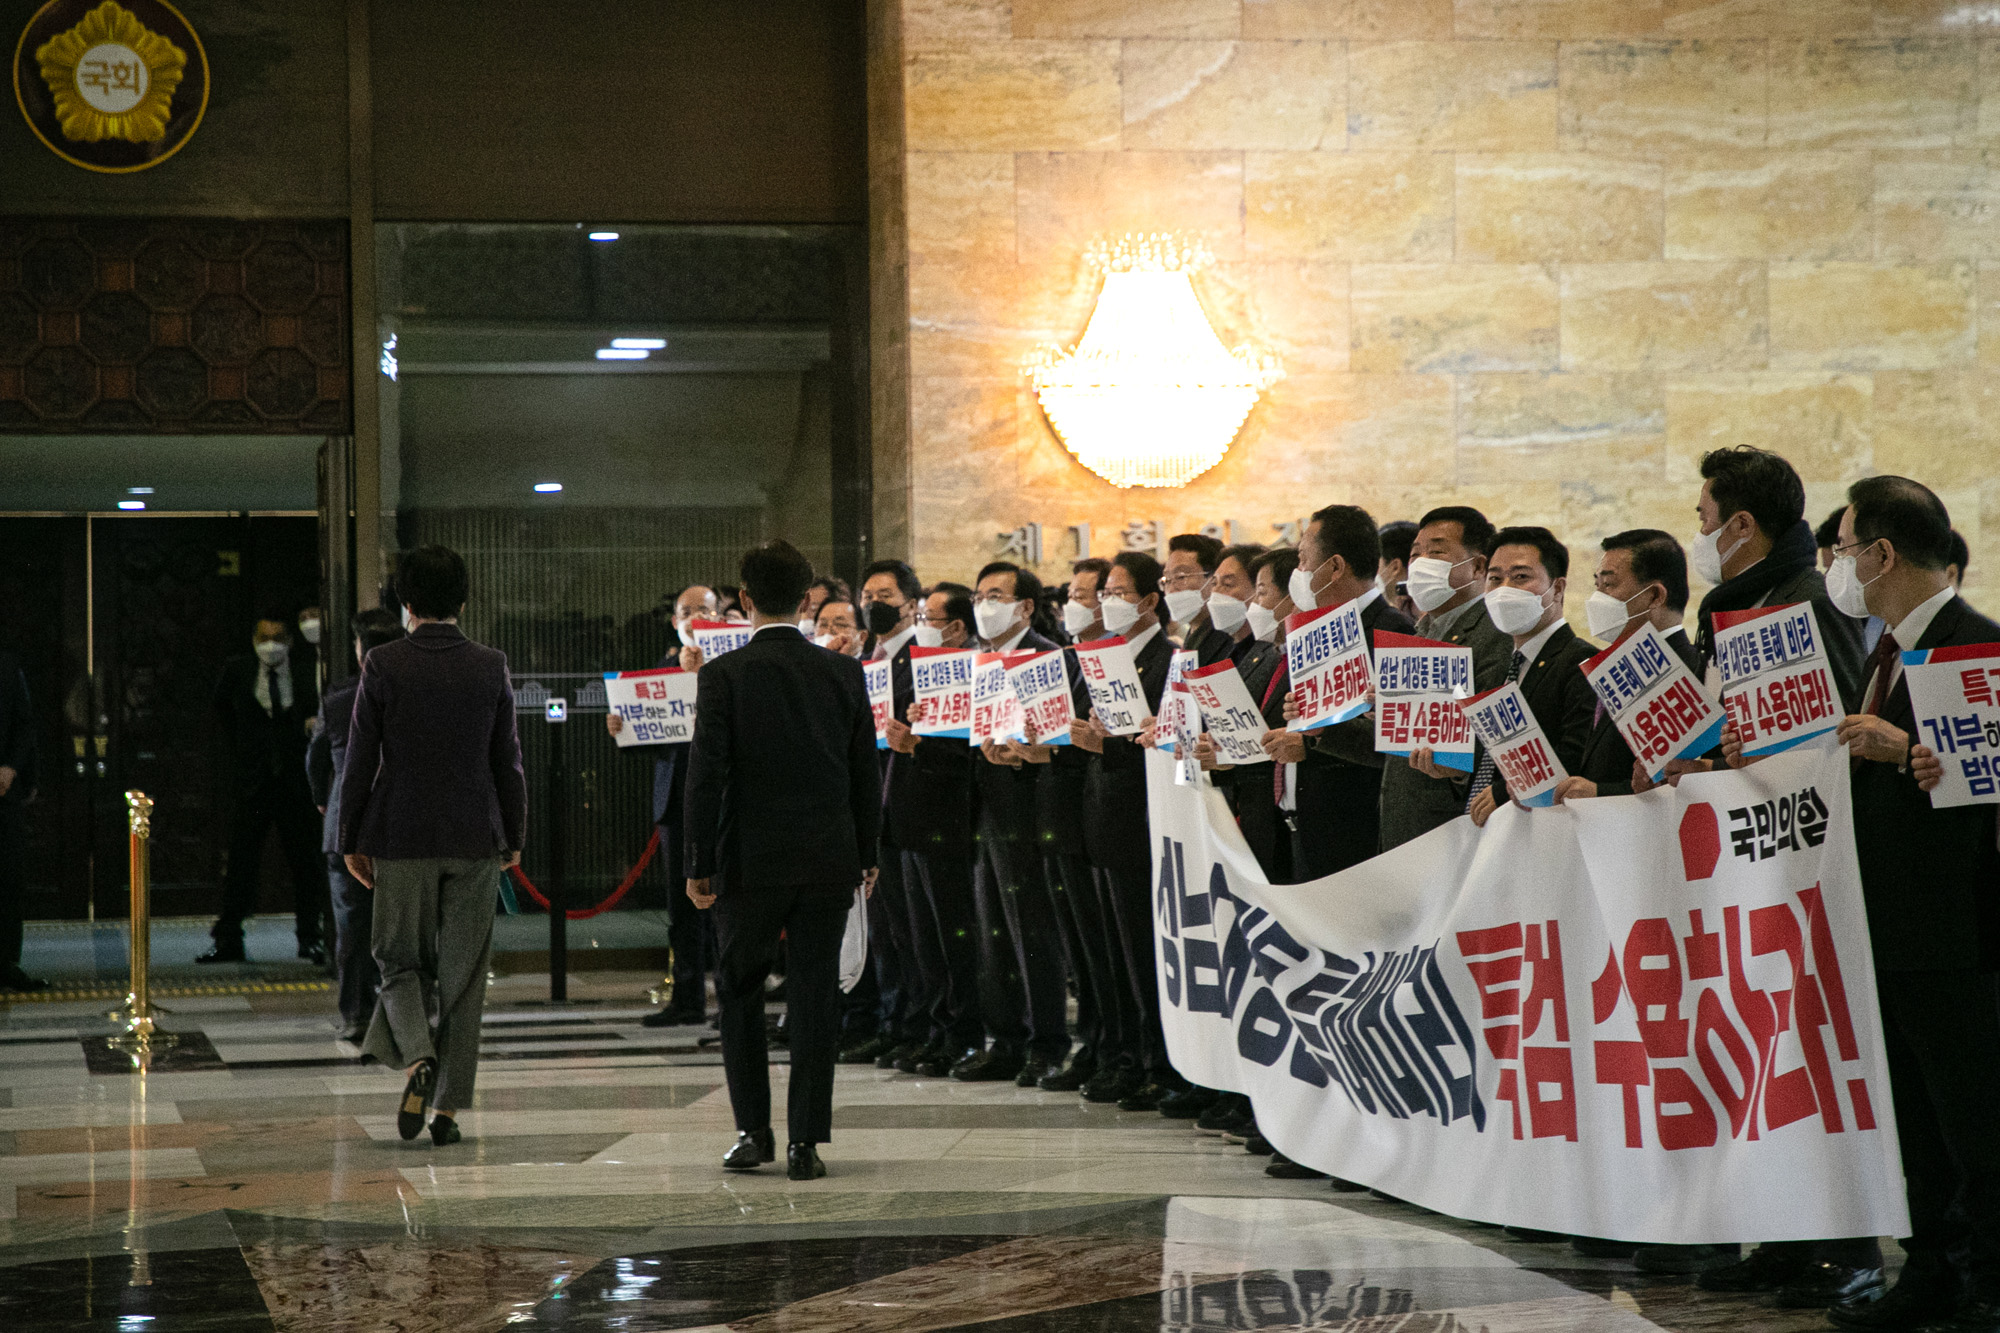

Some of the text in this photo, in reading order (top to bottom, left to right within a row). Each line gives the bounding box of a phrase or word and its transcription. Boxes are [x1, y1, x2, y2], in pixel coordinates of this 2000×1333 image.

[81, 61, 140, 96] 국회
[1290, 607, 1361, 673] 성남 대장동 특혜 비리
[1729, 632, 1761, 677] 대장동
[1759, 621, 1788, 666] 특혜
[1783, 611, 1816, 657] 비리
[917, 664, 930, 689] 성남
[931, 661, 951, 687] 대장동
[1080, 656, 1106, 680] 특검
[1379, 655, 1469, 690] 성남 대장동 특혜 비리
[1608, 654, 1646, 698] 특혜
[1631, 632, 1672, 679] 비리
[634, 680, 667, 700] 특검
[1108, 678, 1139, 702] 자가
[1190, 683, 1222, 709] 특검
[1294, 653, 1371, 721] 특검 수용하라!
[1756, 667, 1836, 738] 수용하라!
[615, 703, 668, 723] 거부하는
[1225, 706, 1259, 731] 자가
[1381, 701, 1411, 744] 특검
[1413, 700, 1471, 745] 수용하라!
[1494, 691, 1528, 732] 비리
[1627, 675, 1712, 765] 수용하라!
[633, 721, 688, 742] 범인이다
[1728, 786, 1830, 863] 국민의힘
[1456, 919, 1579, 1143] 특검
[1591, 880, 1878, 1151] 수용하라!
